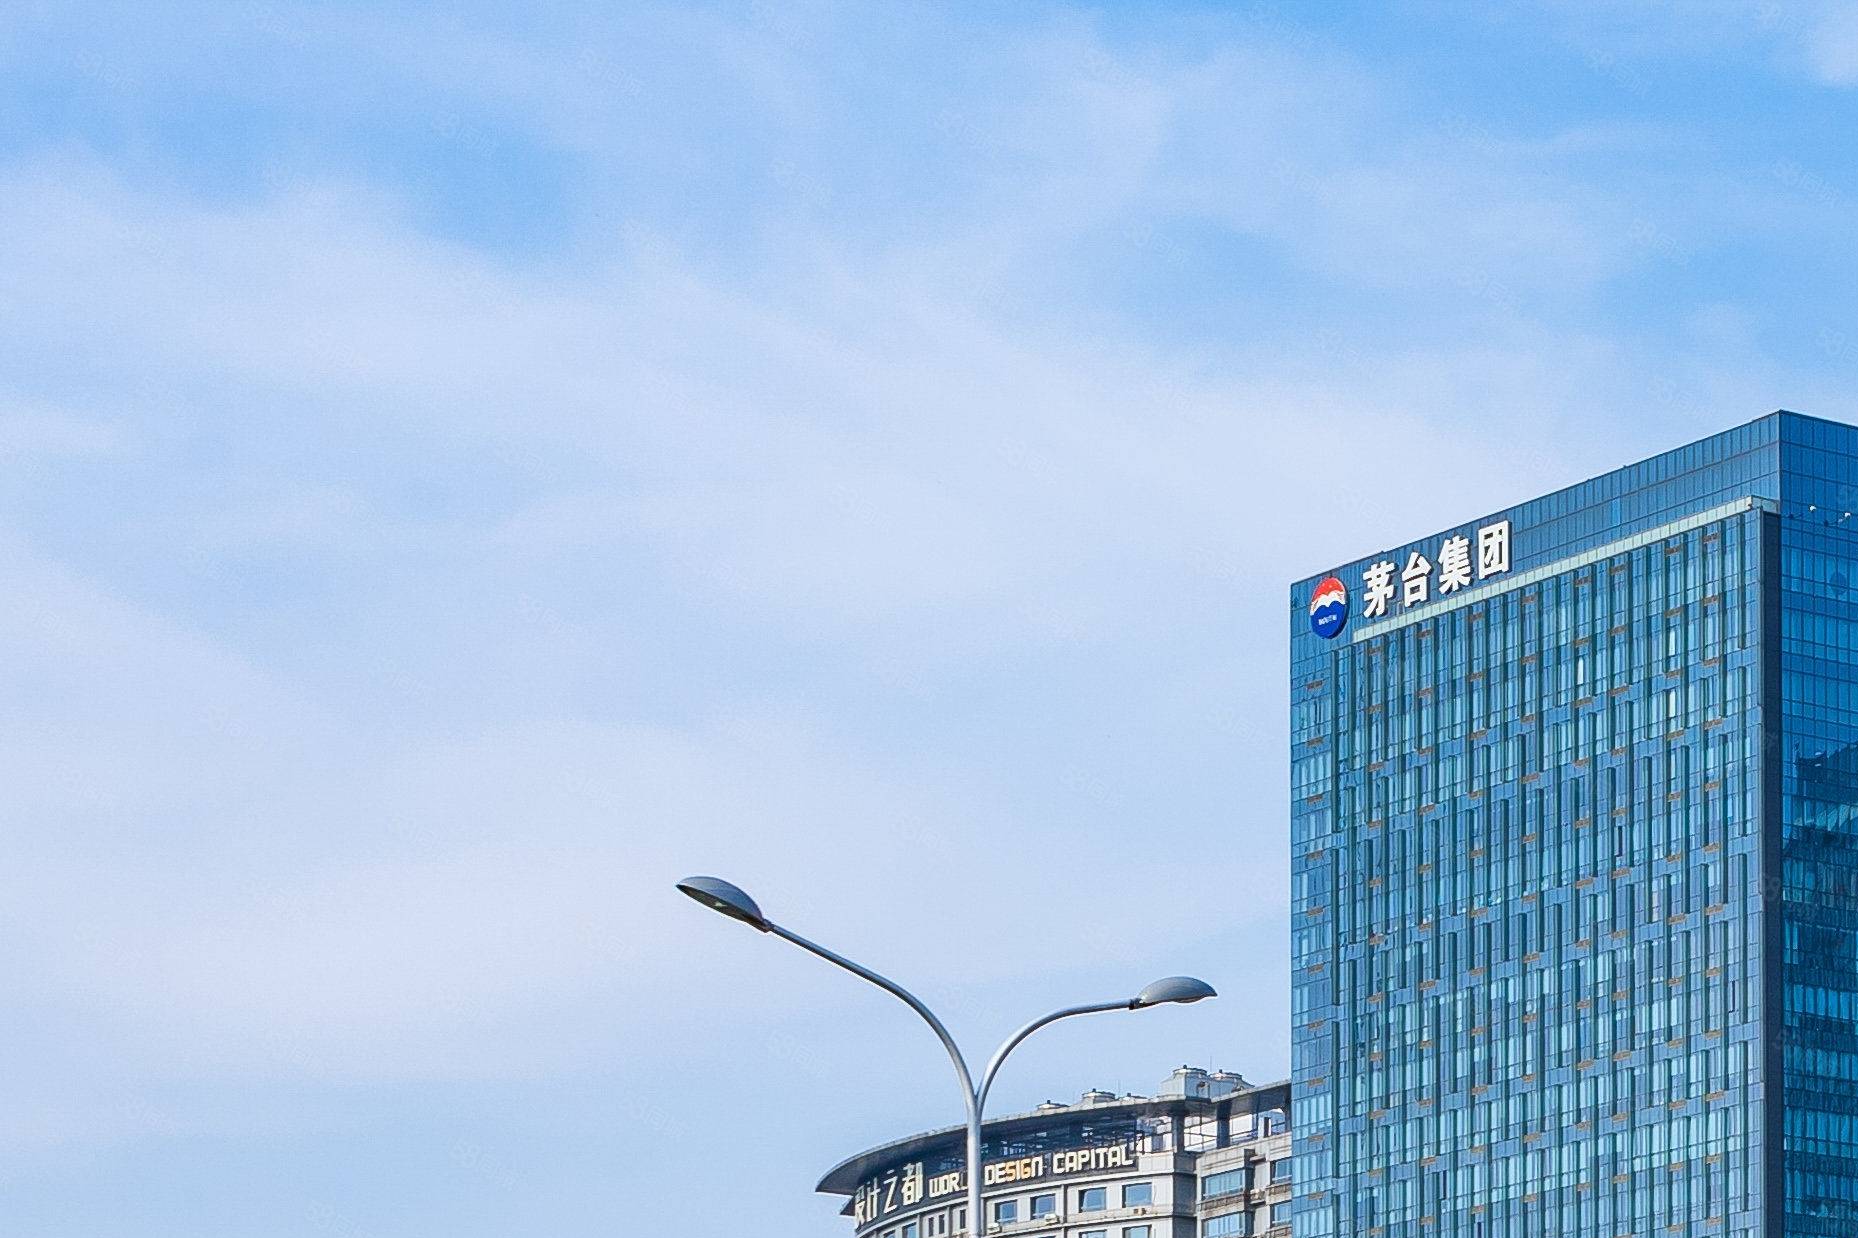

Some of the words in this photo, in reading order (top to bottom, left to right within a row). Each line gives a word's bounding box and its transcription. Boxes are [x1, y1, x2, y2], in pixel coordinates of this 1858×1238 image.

[1362, 520, 1512, 618] 茅台集团
[928, 1170, 968, 1198] WORL
[984, 1156, 1043, 1186] DESIGN
[1053, 1143, 1134, 1174] CAPITAL
